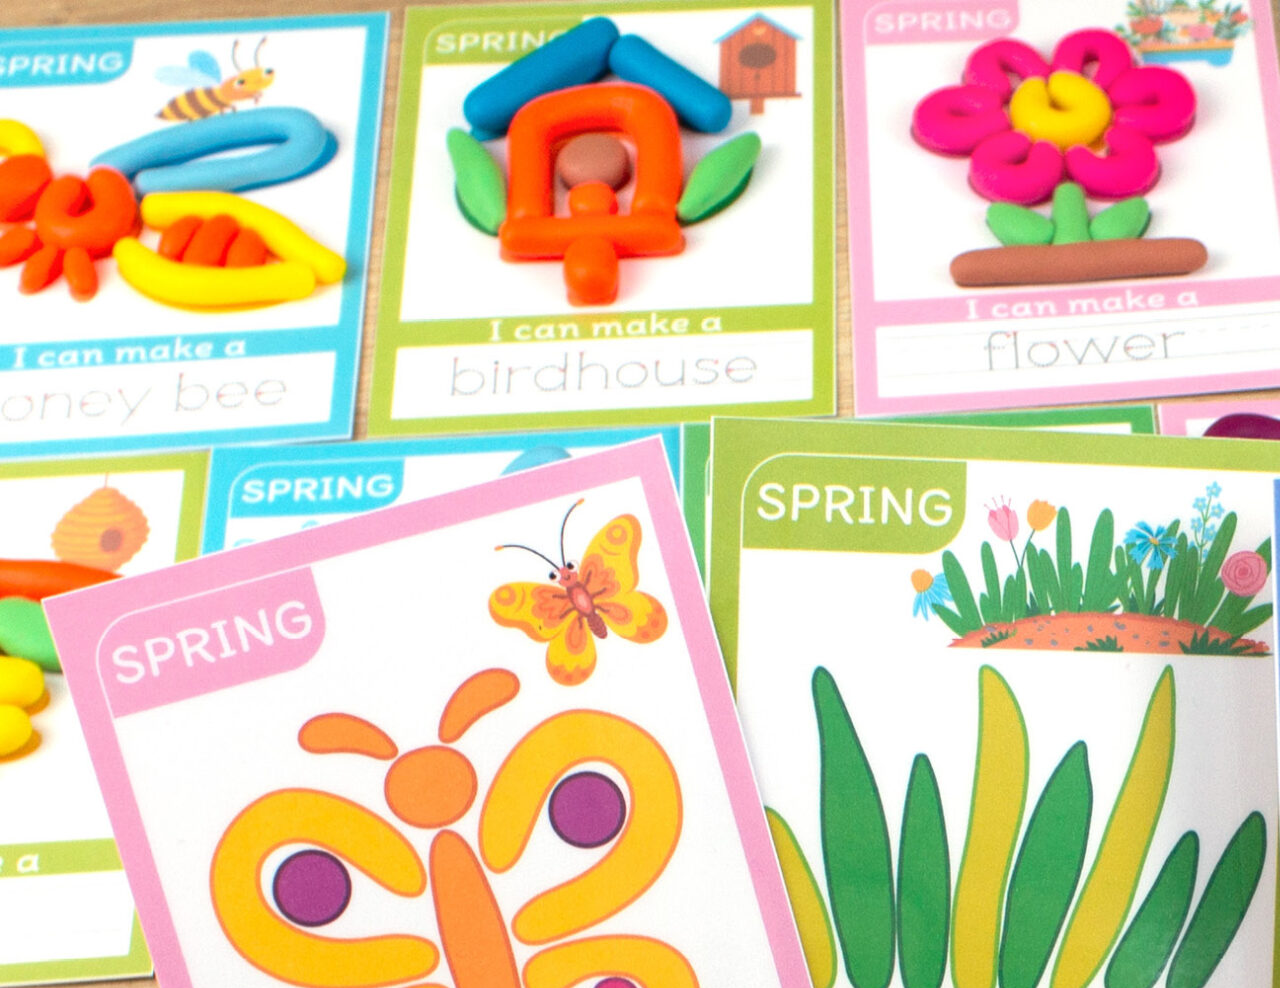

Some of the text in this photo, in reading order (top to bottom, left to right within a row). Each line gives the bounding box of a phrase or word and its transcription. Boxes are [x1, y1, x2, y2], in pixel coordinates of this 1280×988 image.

[874, 8, 1012, 34] SPRING
[436, 29, 568, 54] SPRIN
[966, 289, 1198, 320] I can make a
[489, 312, 722, 342] I can make a
[13, 337, 247, 368] I can make a
[984, 331, 1186, 371] flower
[450, 351, 757, 396] birdhouse
[175, 372, 287, 411] bee
[242, 473, 394, 504] SPRING
[756, 482, 954, 528] SPRING
[111, 600, 314, 684] SPRING
[17, 853, 40, 874] a
